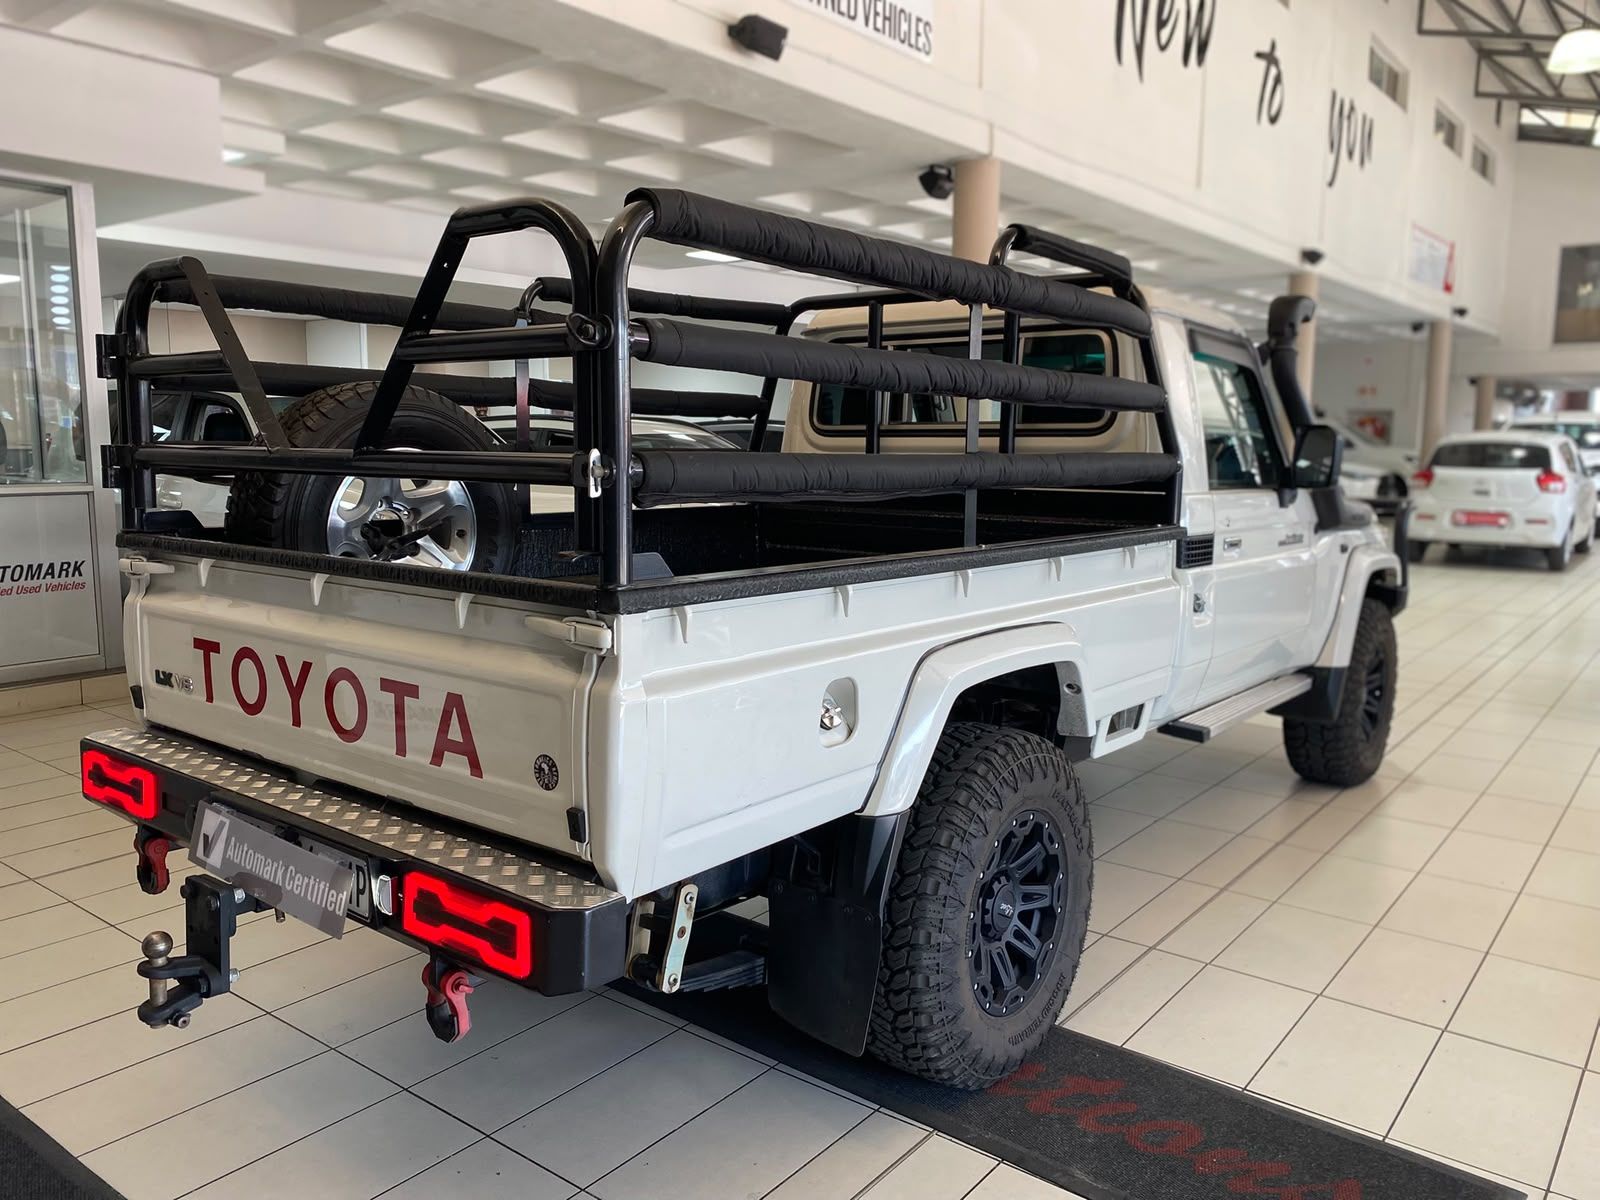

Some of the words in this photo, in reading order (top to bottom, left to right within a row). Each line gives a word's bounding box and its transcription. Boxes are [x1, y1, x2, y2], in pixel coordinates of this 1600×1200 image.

[862, 0, 932, 56] VEHICLES
[1115, 0, 1216, 83] New
[1254, 38, 1285, 126] to
[1326, 88, 1374, 188] you
[0, 586, 14, 597] ed
[16, 584, 42, 596] Used
[45, 581, 86, 593] Vehicles
[193, 637, 484, 780] TOYOTA
[226, 836, 285, 887] Automark
[285, 865, 347, 917] Certified
